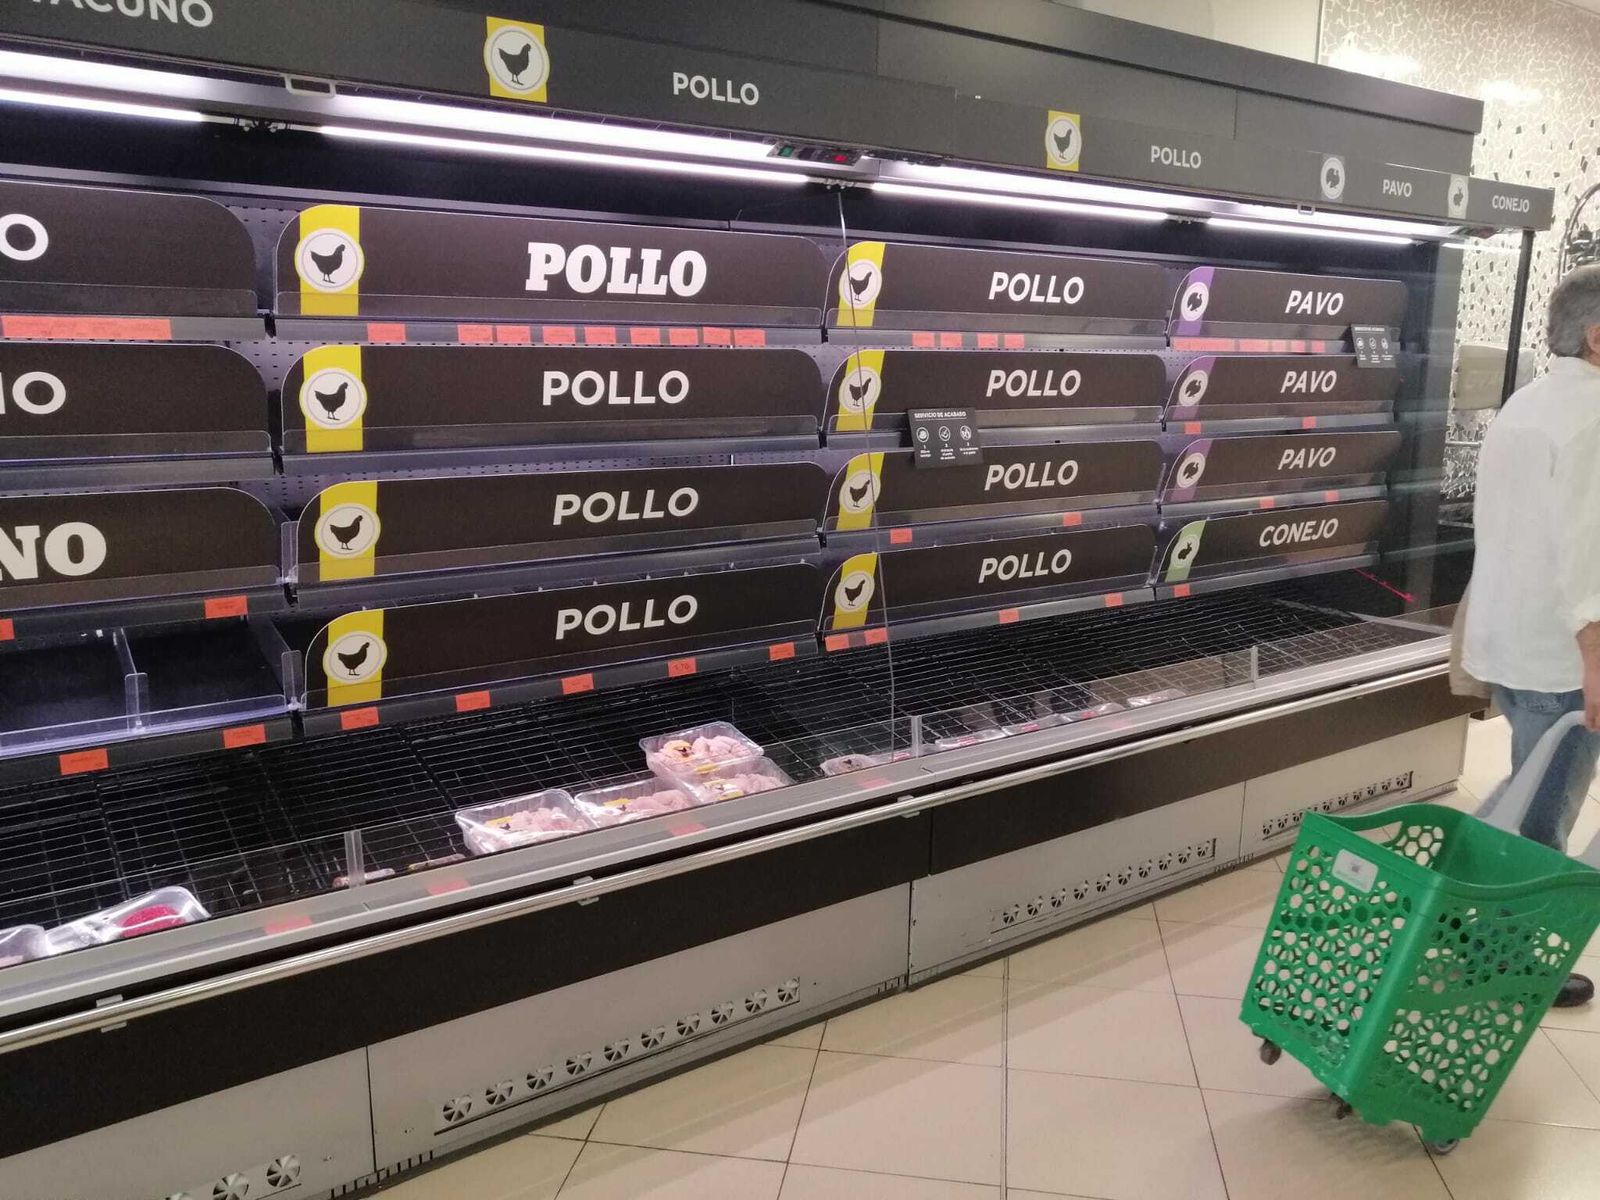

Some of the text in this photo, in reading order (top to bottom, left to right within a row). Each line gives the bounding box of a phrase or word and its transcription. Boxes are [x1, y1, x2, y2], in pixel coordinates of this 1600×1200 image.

[33, 0, 213, 28] UNO
[672, 71, 760, 106] POLLO
[1150, 145, 1202, 169] POLLO
[1382, 178, 1413, 198] PAVO
[1491, 194, 1531, 214] CONEJO
[525, 241, 707, 297] POLLO
[988, 271, 1085, 305] POLLO
[1284, 289, 1344, 316] PAVO
[0, 371, 67, 415] O
[542, 370, 690, 406] POLLO
[985, 369, 1082, 397] POLLO
[1280, 369, 1338, 394] PAVO
[1277, 446, 1337, 471] PAVO
[984, 459, 1079, 491] POLLO
[552, 487, 699, 526] POLLO
[1259, 517, 1339, 547] CONEJO
[978, 548, 1072, 584] POLLO
[555, 594, 698, 640] POLLO
